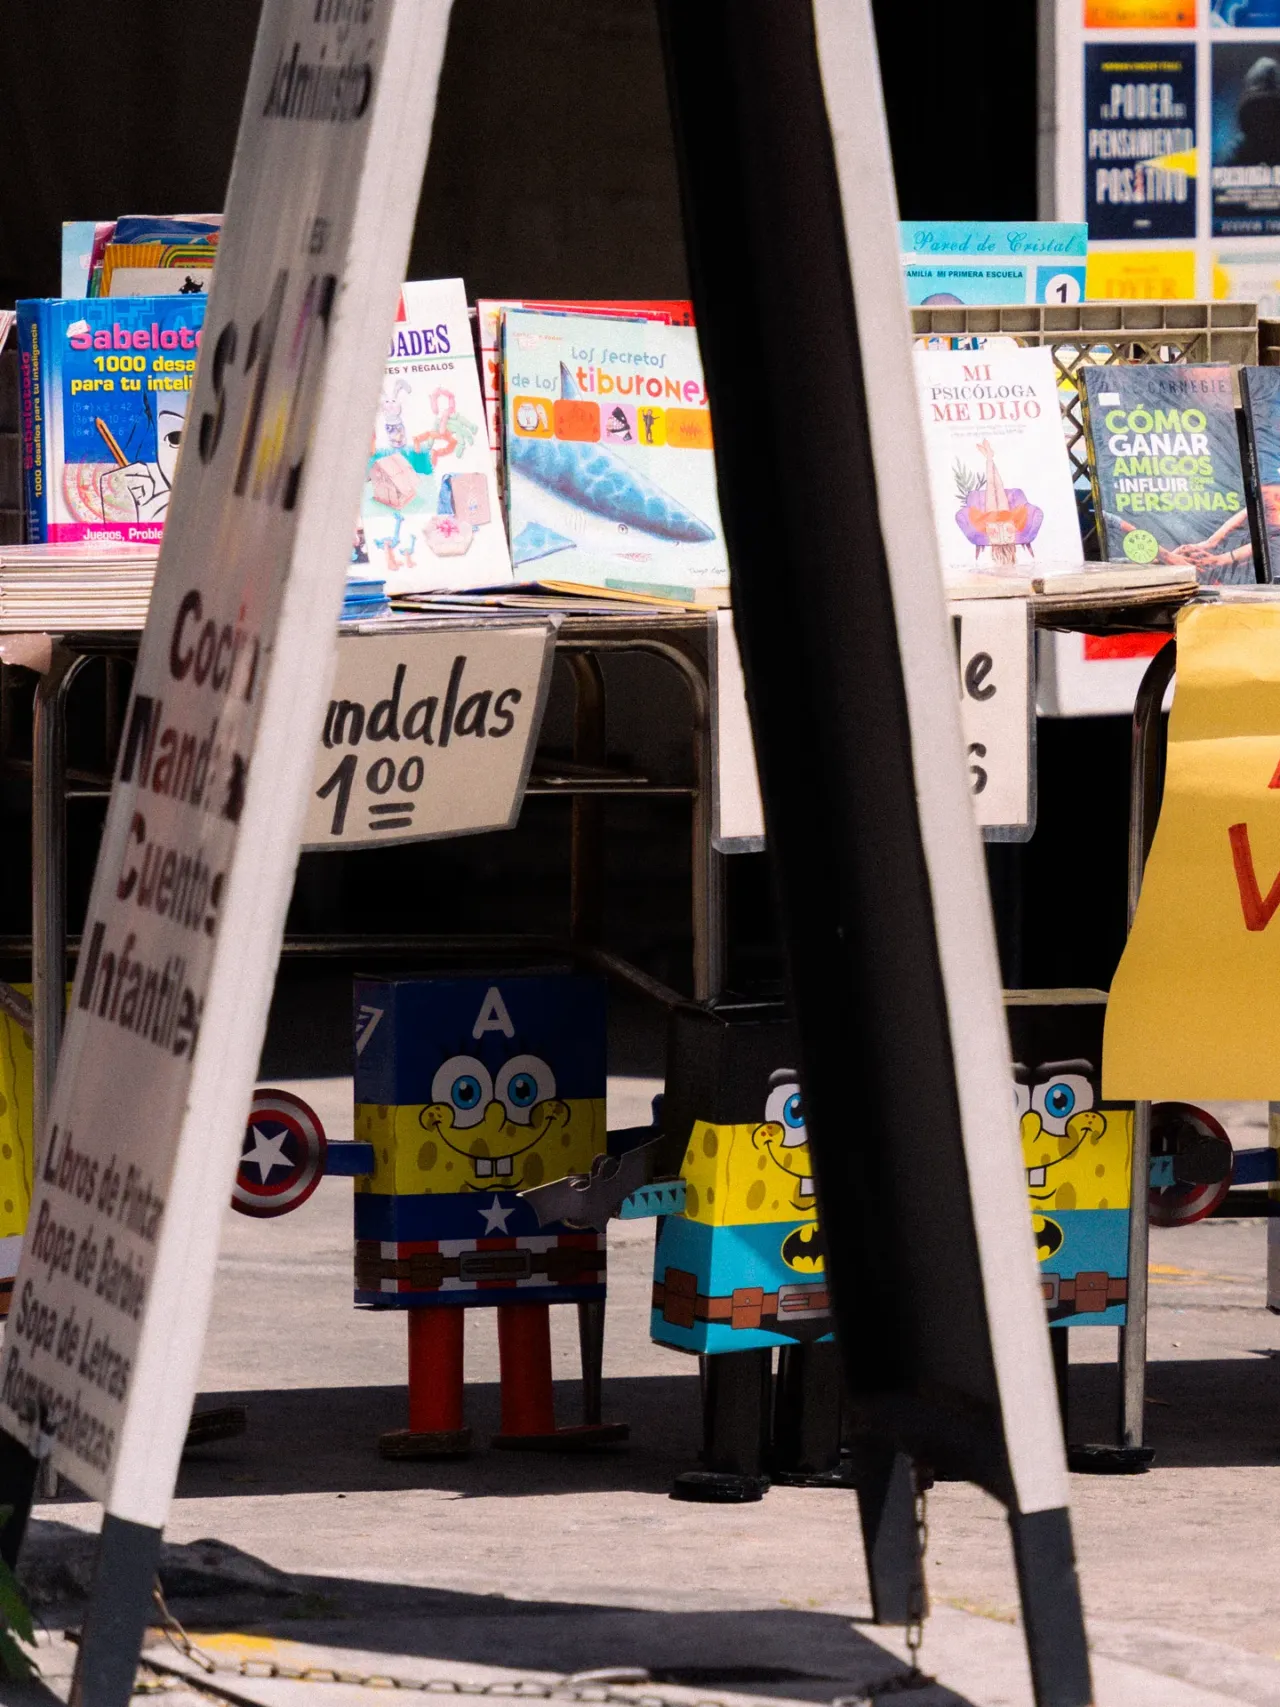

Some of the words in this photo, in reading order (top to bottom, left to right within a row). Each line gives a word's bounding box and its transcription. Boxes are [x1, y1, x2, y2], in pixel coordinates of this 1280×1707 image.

[1110, 83, 1173, 120] PODER
[913, 230, 973, 252] Pared
[977, 235, 996, 252] de
[1007, 231, 1075, 252] Cristal
[937, 270, 947, 278] MI
[948, 270, 984, 278] PRIMERA
[986, 270, 1023, 279] ESCUELA
[1056, 283, 1068, 303] 1
[30, 323, 40, 380] inteligencia
[94, 356, 146, 372] 1000
[411, 362, 455, 373] REGALOS
[962, 364, 992, 382] MI
[32, 382, 40, 394] tu
[71, 379, 114, 396] para
[121, 377, 141, 391] tu
[512, 373, 531, 388] de
[1148, 379, 1227, 394] CARNEGIE
[931, 384, 1037, 400] PSICÓLOGA
[22, 352, 33, 469] Sabelotodo
[33, 398, 42, 421] para
[931, 402, 971, 422] ME
[977, 400, 1041, 421] DIJO
[1105, 403, 1207, 434] CÓMO
[1108, 433, 1211, 457] GANAR
[1113, 455, 1213, 477] AMIGOS
[34, 470, 43, 498] 1000
[1119, 477, 1188, 493] INFLUIR
[1115, 491, 1240, 512] PERSONAS
[98, 1154, 121, 1218] de
[31, 1199, 76, 1282] Ropa
[74, 1225, 98, 1287] de
[16, 1278, 58, 1360] Sopa
[57, 1305, 80, 1367] de
